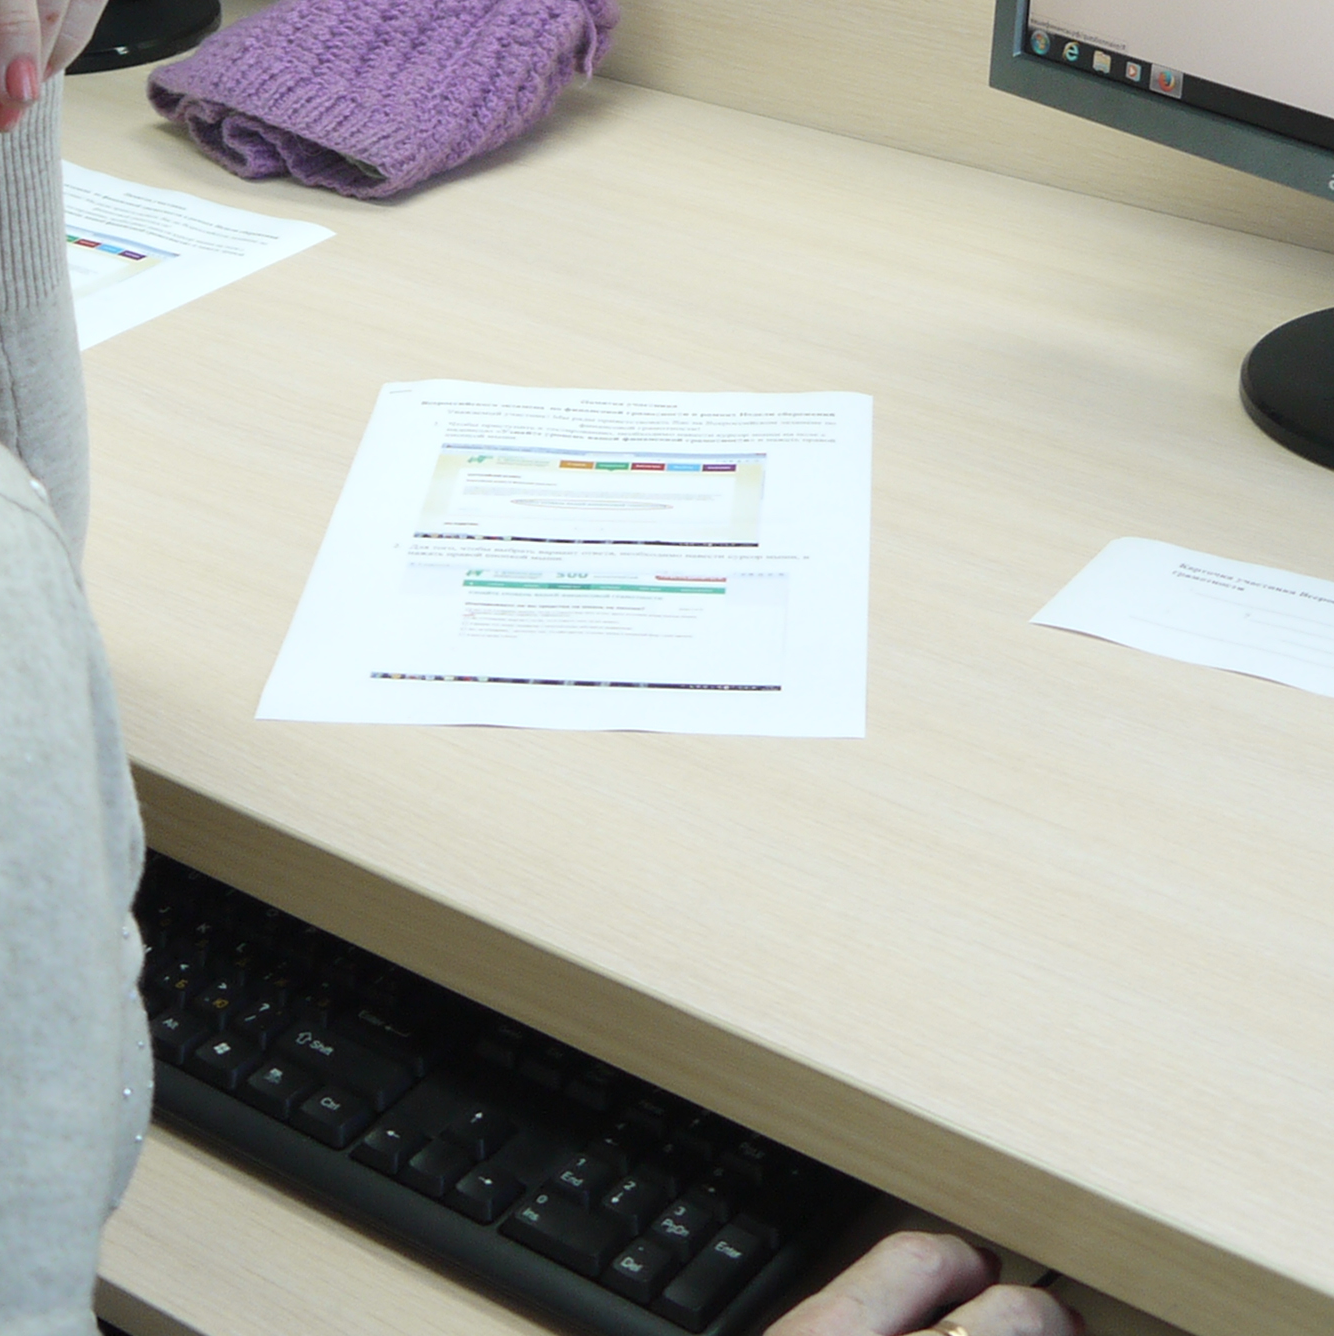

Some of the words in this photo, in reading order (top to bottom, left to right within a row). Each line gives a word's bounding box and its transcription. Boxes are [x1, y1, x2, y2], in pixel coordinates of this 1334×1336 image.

[310, 1040, 334, 1056] Shift
[320, 1096, 340, 1111] Ctrl
[560, 1170, 584, 1187] End
